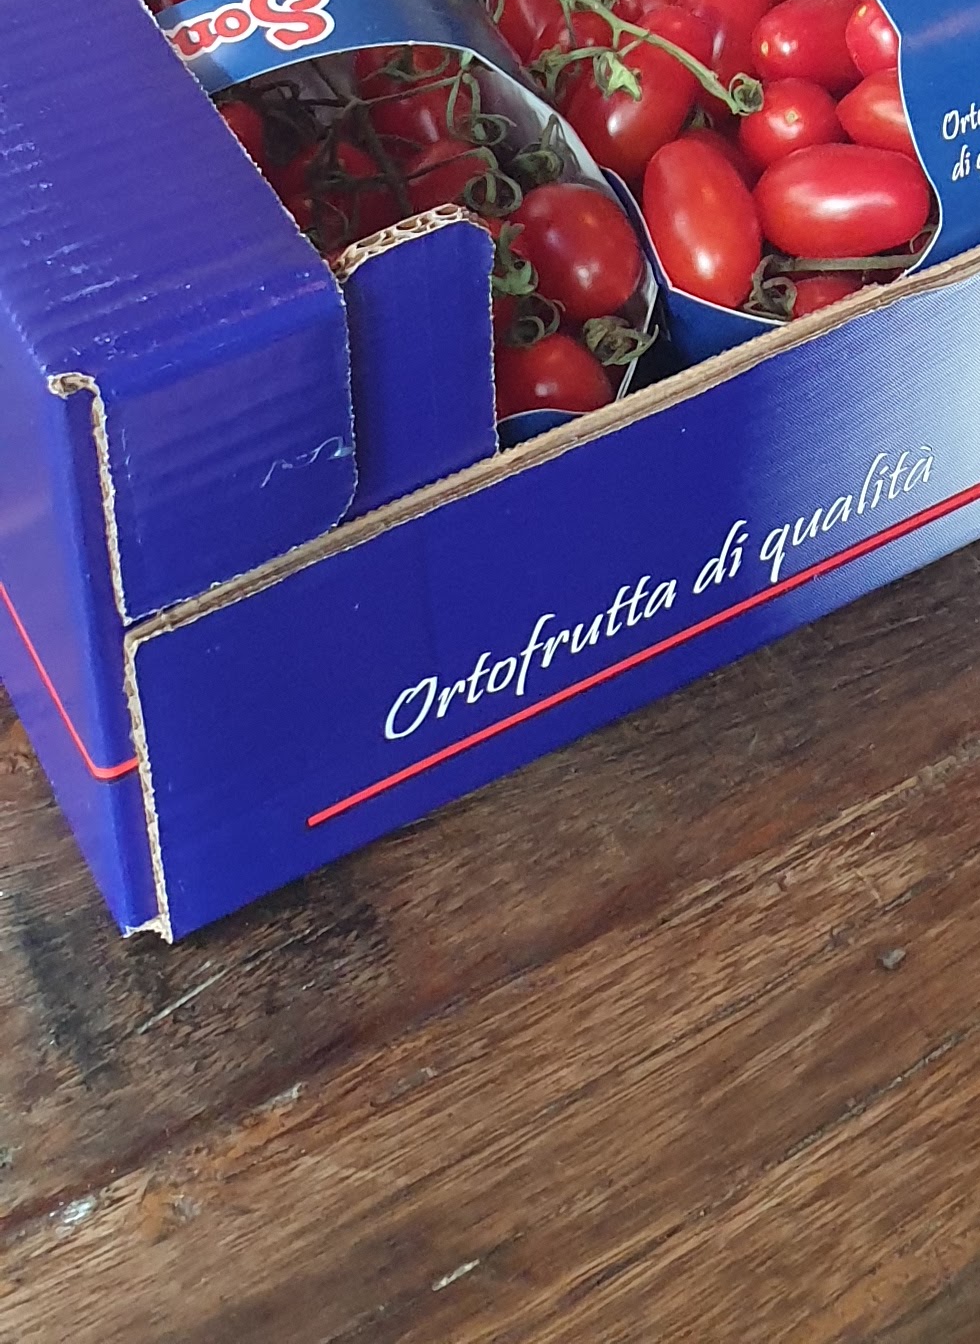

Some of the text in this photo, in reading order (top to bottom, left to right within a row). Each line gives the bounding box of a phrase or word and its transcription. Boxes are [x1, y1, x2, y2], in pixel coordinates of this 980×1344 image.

[951, 146, 973, 183] di
[384, 442, 936, 742] Ortofrutta di qualità
